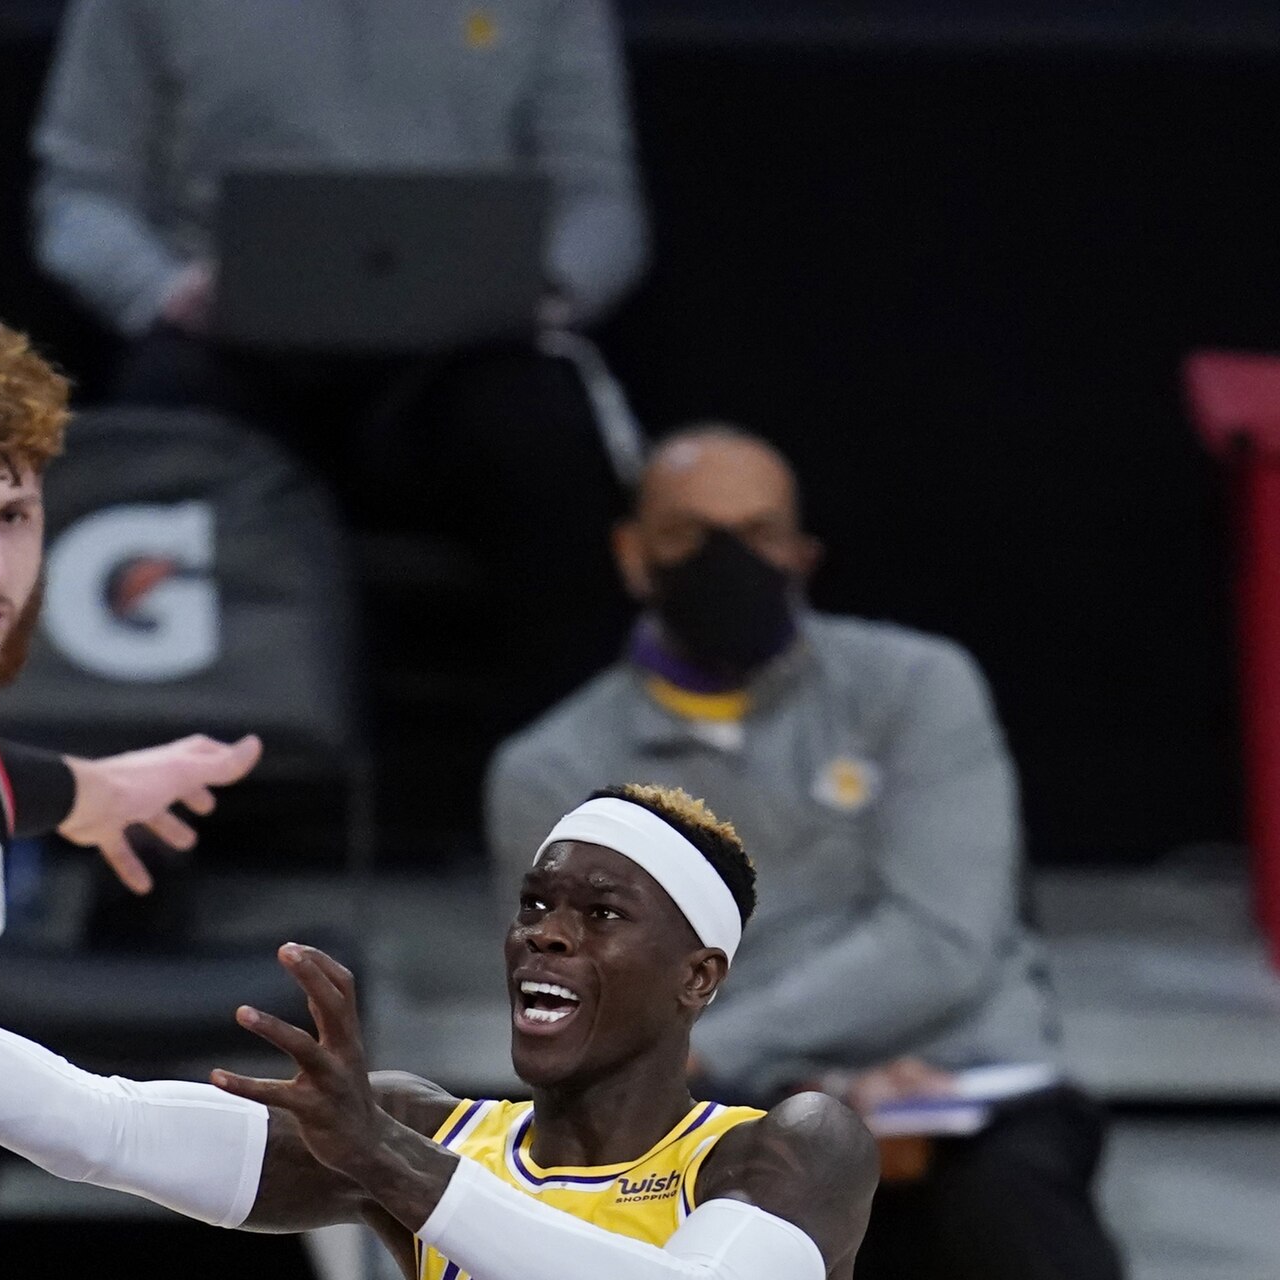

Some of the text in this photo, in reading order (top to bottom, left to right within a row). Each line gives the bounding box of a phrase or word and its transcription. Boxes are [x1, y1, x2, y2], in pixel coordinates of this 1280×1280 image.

[45, 500, 218, 680] G
[618, 1169, 681, 1195] wish
[615, 1189, 678, 1204] SHOPPING
